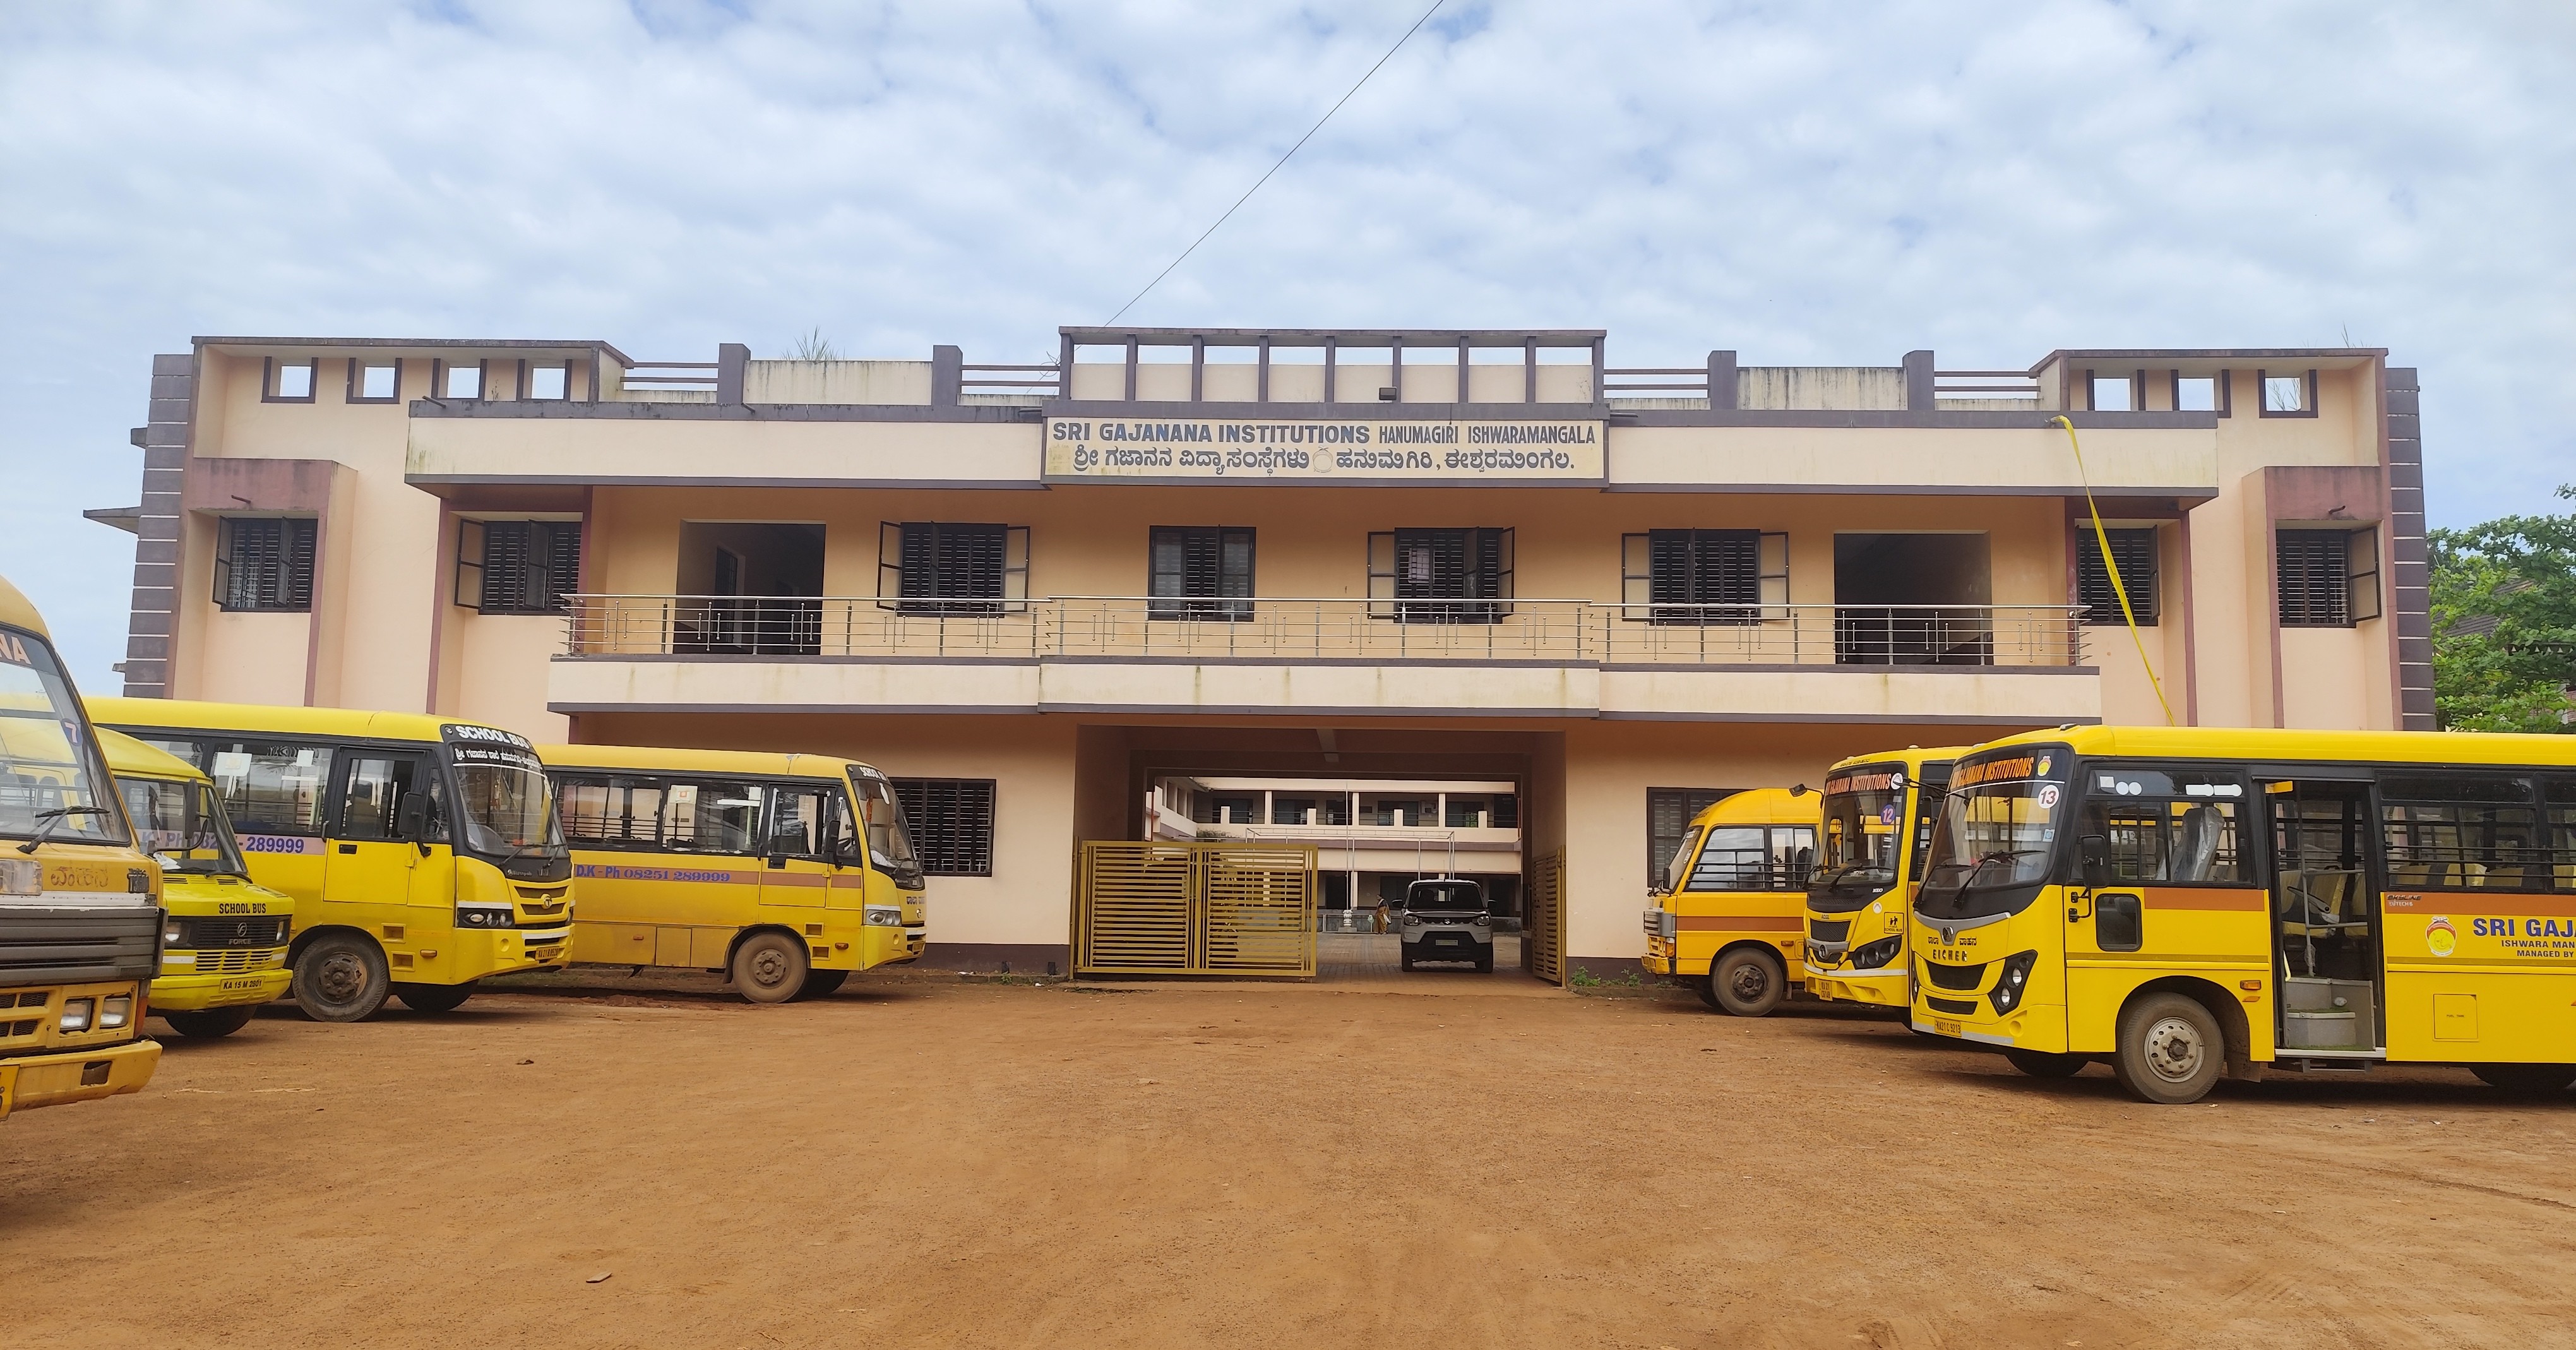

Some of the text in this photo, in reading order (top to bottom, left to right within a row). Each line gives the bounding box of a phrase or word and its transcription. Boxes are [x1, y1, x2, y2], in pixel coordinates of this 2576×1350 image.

[1053, 422, 1595, 444] SRI GAJANANA INSTITUTIONS HANUMAGIRI ISHWARAMANGALA
[1073, 444, 1098, 472] ಶ್ರೀ
[1106, 447, 1172, 467] ಗಜಾನನ
[1444, 449, 1575, 472] ಈಶ್ವರಮಂಗಲ.
[64, 722, 78, 743] 7
[455, 726, 530, 750] SCHOOL BUS
[1983, 757, 2034, 781] INSTITUTIONS
[1850, 773, 1892, 791] INSTITUTIONS
[2040, 791, 2056, 804] 13
[1883, 808, 1893, 823] 12
[246, 837, 304, 853] 289999
[576, 865, 595, 877] D.K
[605, 866, 620, 878] Ph
[624, 869, 668, 880] 08251
[673, 871, 730, 882] 289999
[219, 903, 266, 914] SCHOOL BUS
[2473, 918, 2576, 937] SRI GAJ
[1933, 949, 1967, 962] EICHER
[224, 981, 232, 989] KA
